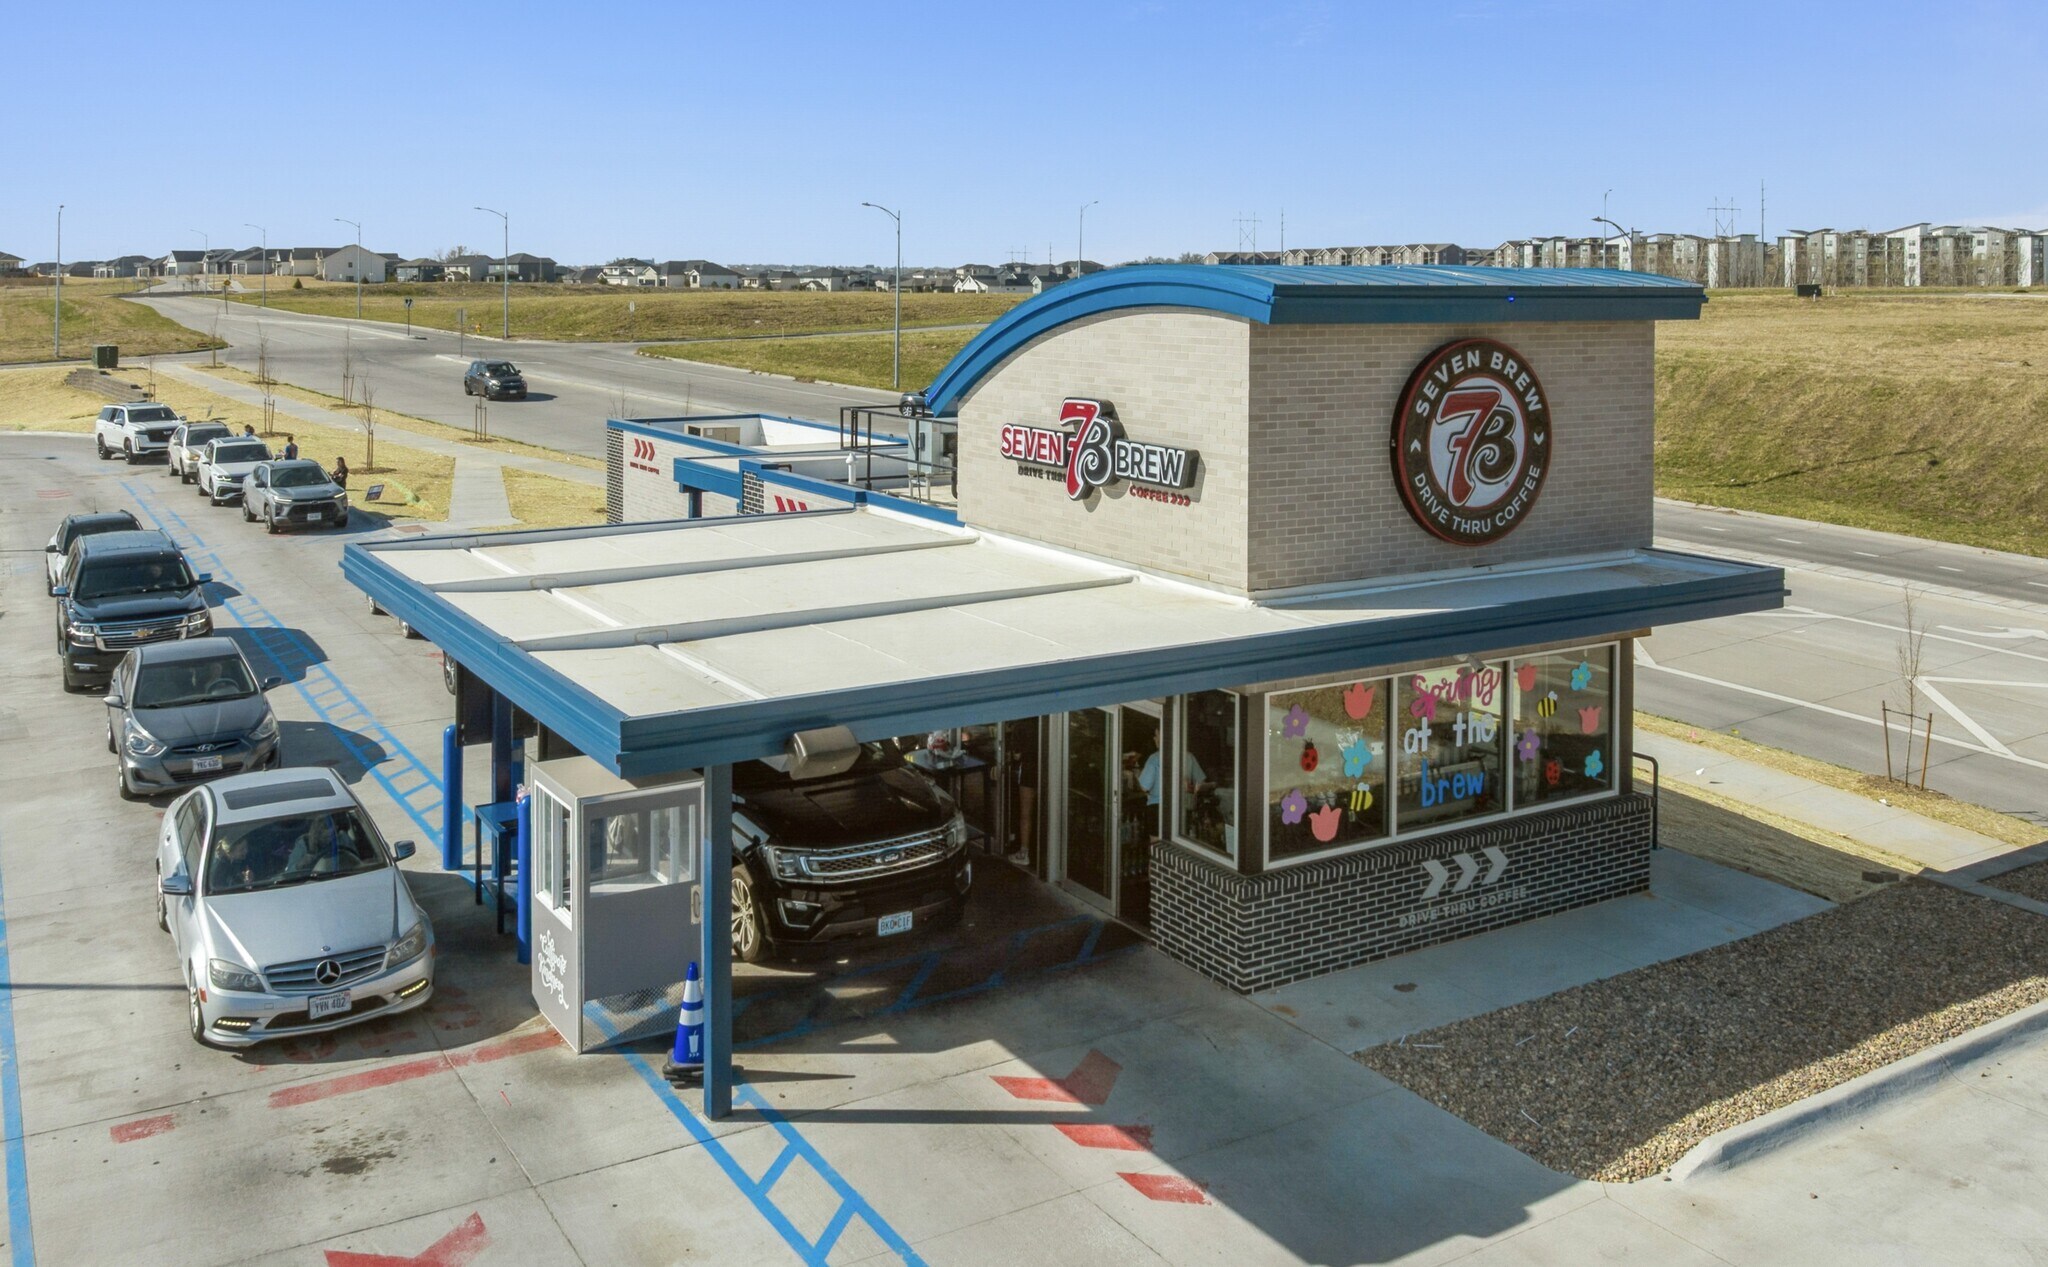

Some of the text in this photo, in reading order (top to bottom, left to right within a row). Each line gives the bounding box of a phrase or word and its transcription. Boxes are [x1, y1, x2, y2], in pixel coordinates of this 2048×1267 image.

[1415, 350, 1542, 417] SEVEN BREW
[1000, 423, 1064, 466] SEVEN
[1115, 440, 1186, 487] BREW
[1017, 465, 1044, 480] DRIVE
[1129, 484, 1169, 503] COFFEE
[1415, 464, 1541, 534] DRIVE THRU COFFEE
[1410, 667, 1500, 721] Spring
[1403, 711, 1496, 755] at the
[1420, 757, 1485, 808] brew
[1399, 887, 1527, 928] DRIVE THRU COFFEE
[331, 997, 347, 1009] 402
